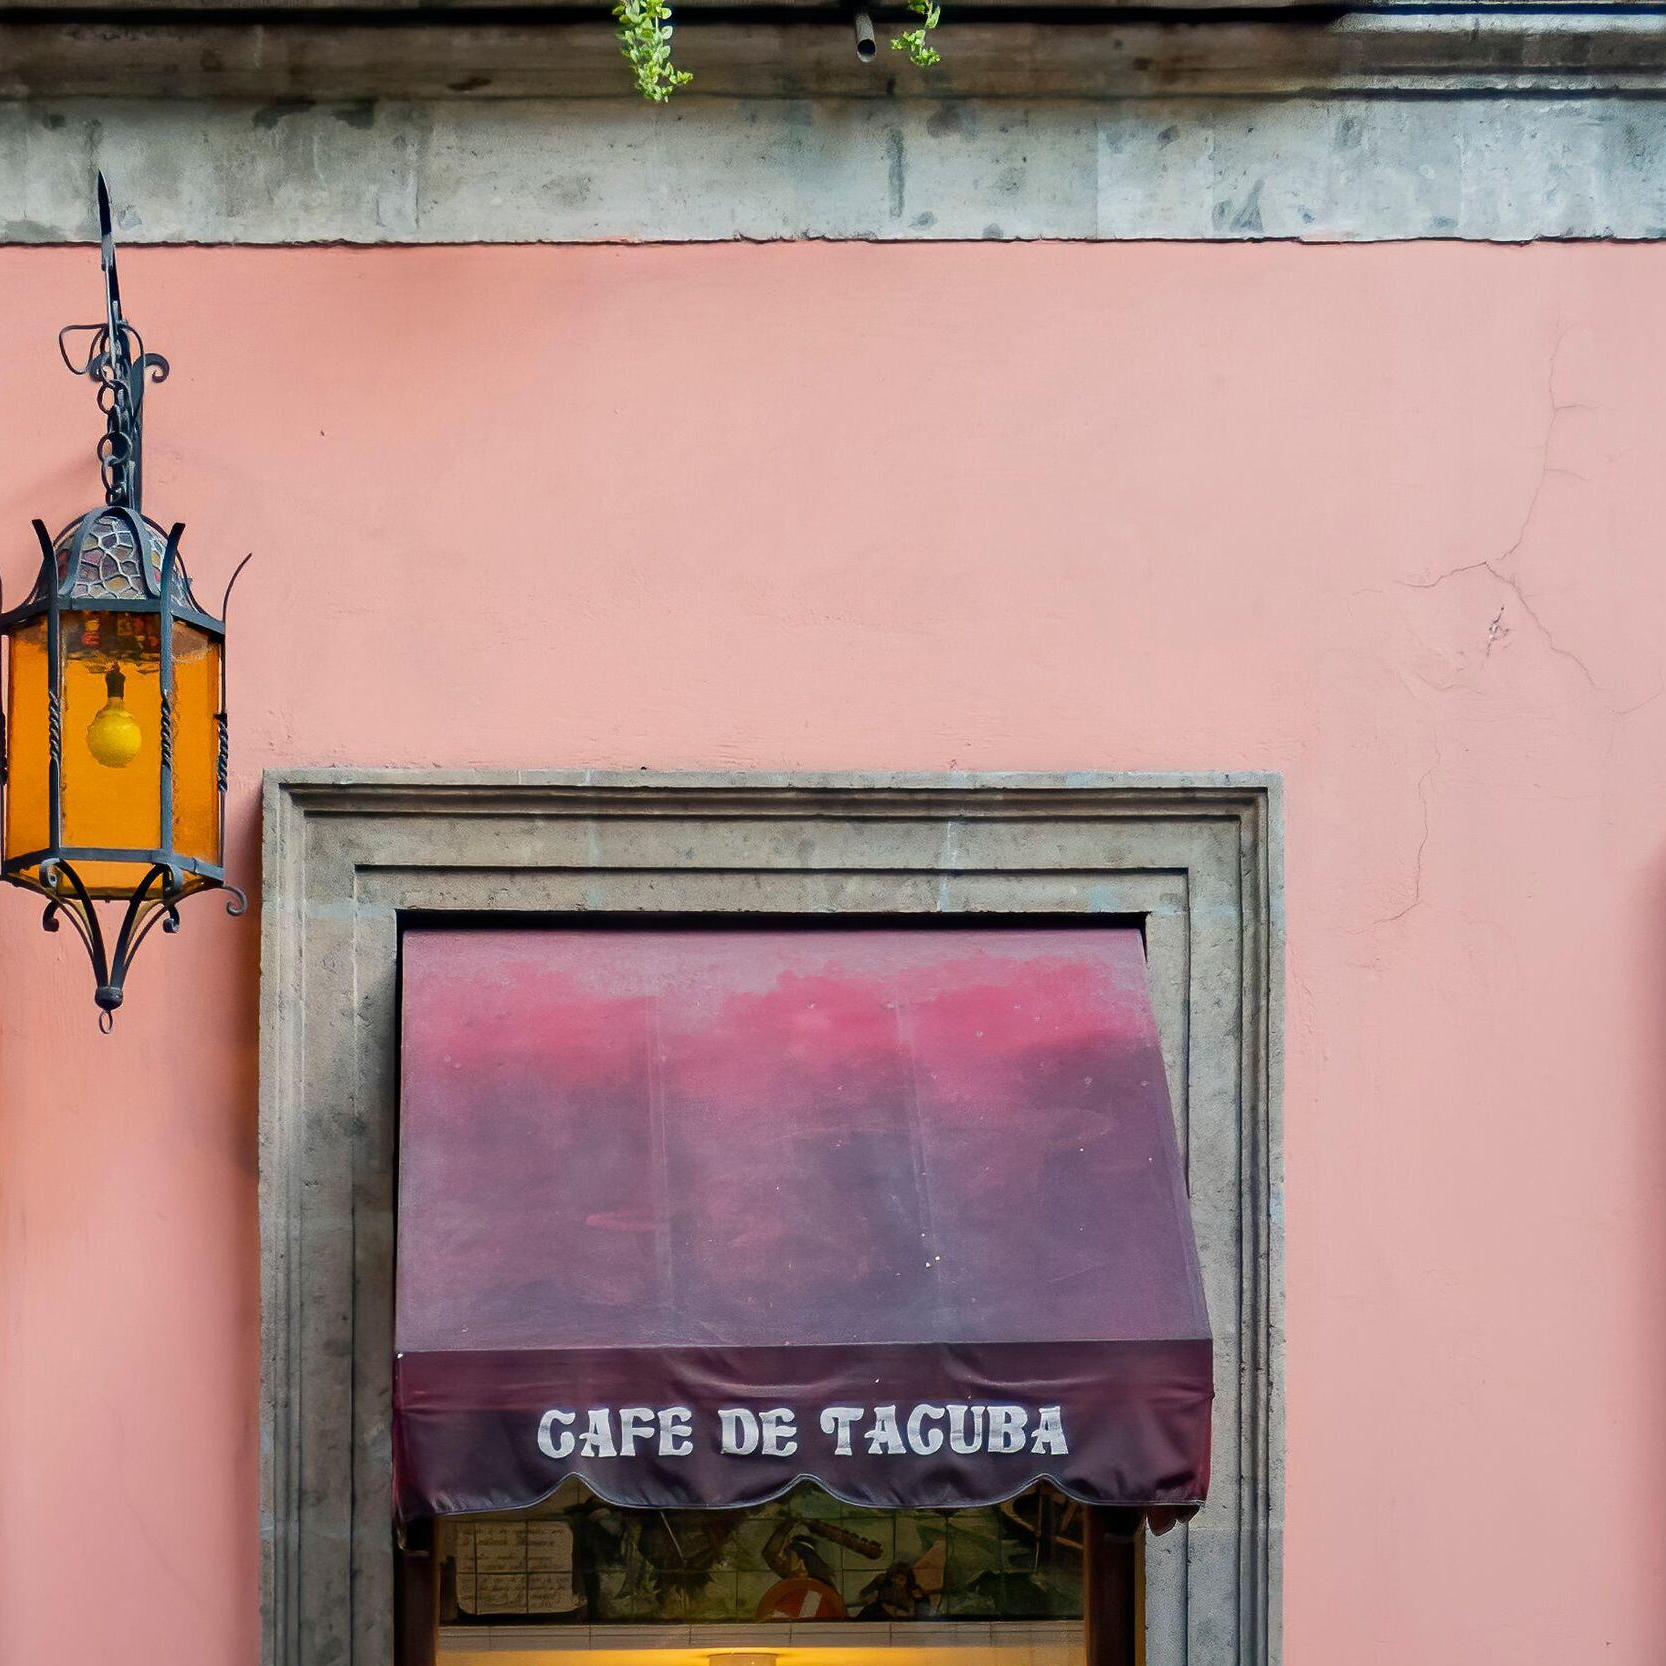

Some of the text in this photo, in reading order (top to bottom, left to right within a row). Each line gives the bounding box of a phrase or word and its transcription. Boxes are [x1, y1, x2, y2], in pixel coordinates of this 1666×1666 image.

[536, 1403, 1069, 1458] CAFE DE TACUBA
